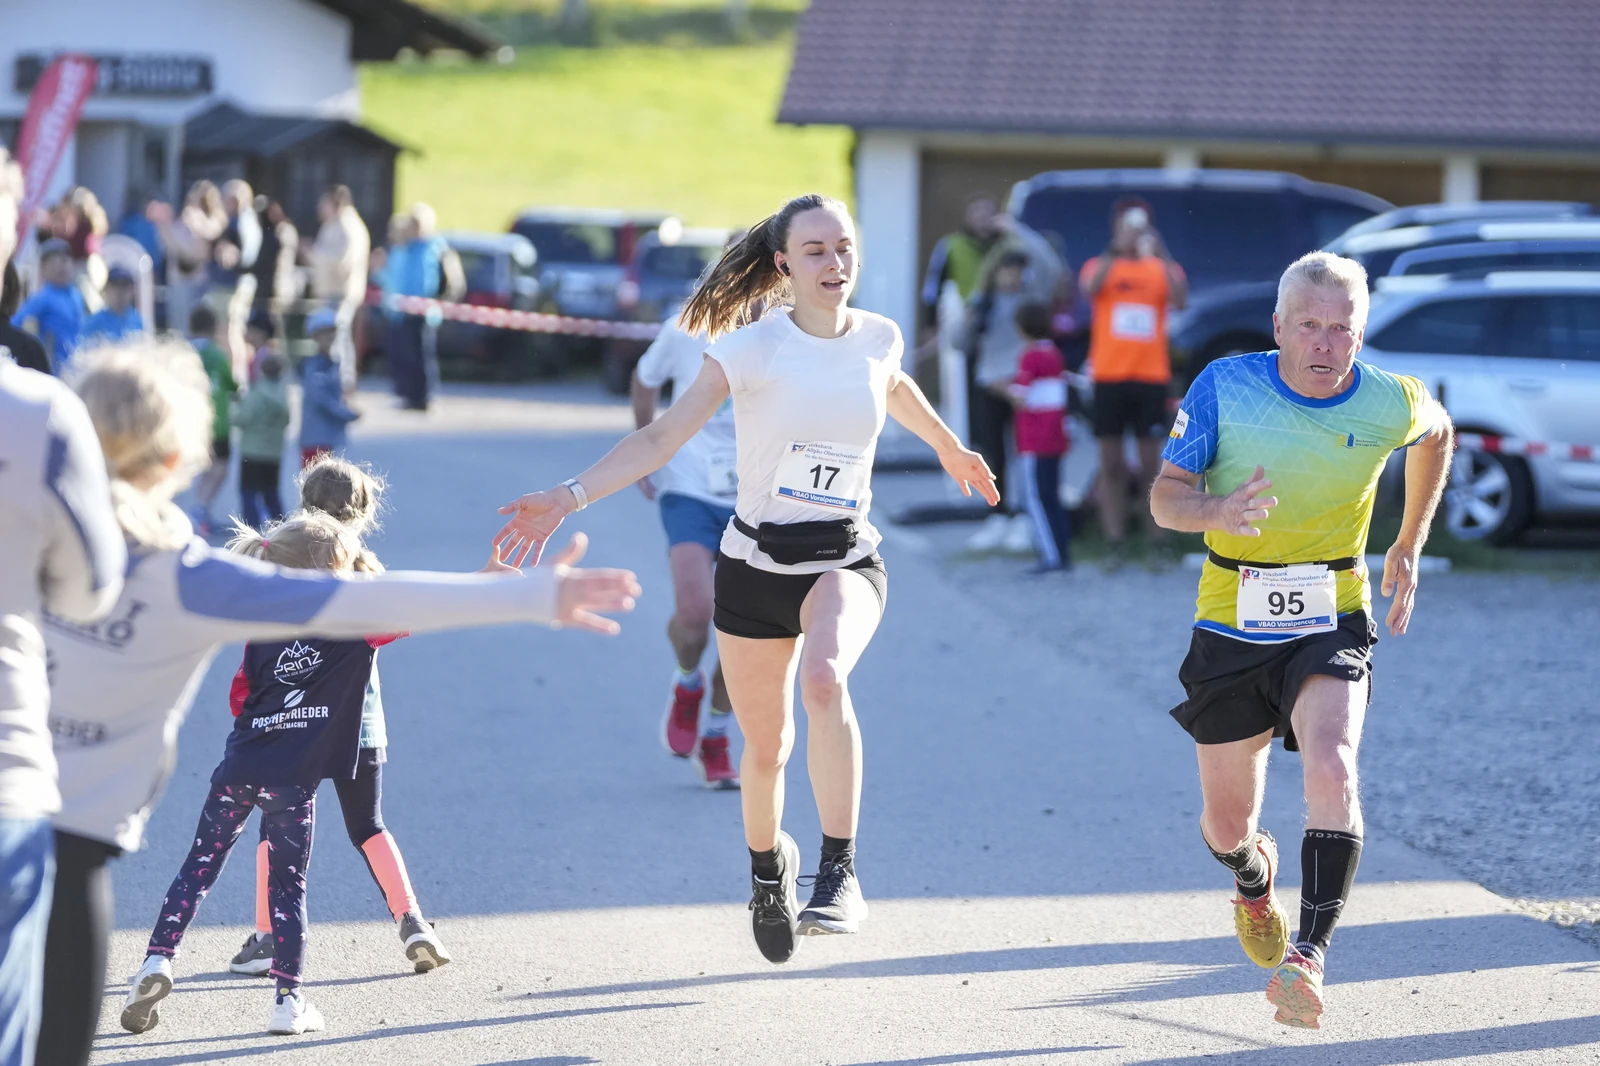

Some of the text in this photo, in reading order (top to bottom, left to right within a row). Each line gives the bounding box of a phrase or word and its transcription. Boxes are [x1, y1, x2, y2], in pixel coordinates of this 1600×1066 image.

[805, 448, 859, 460] Allgäu-Oberschwaben
[810, 464, 841, 491] 17
[791, 490, 847, 506] VBAO Voralpencup
[1268, 591, 1305, 616] 95
[1277, 618, 1317, 627] Voralpencup
[273, 651, 323, 676] PRINZ
